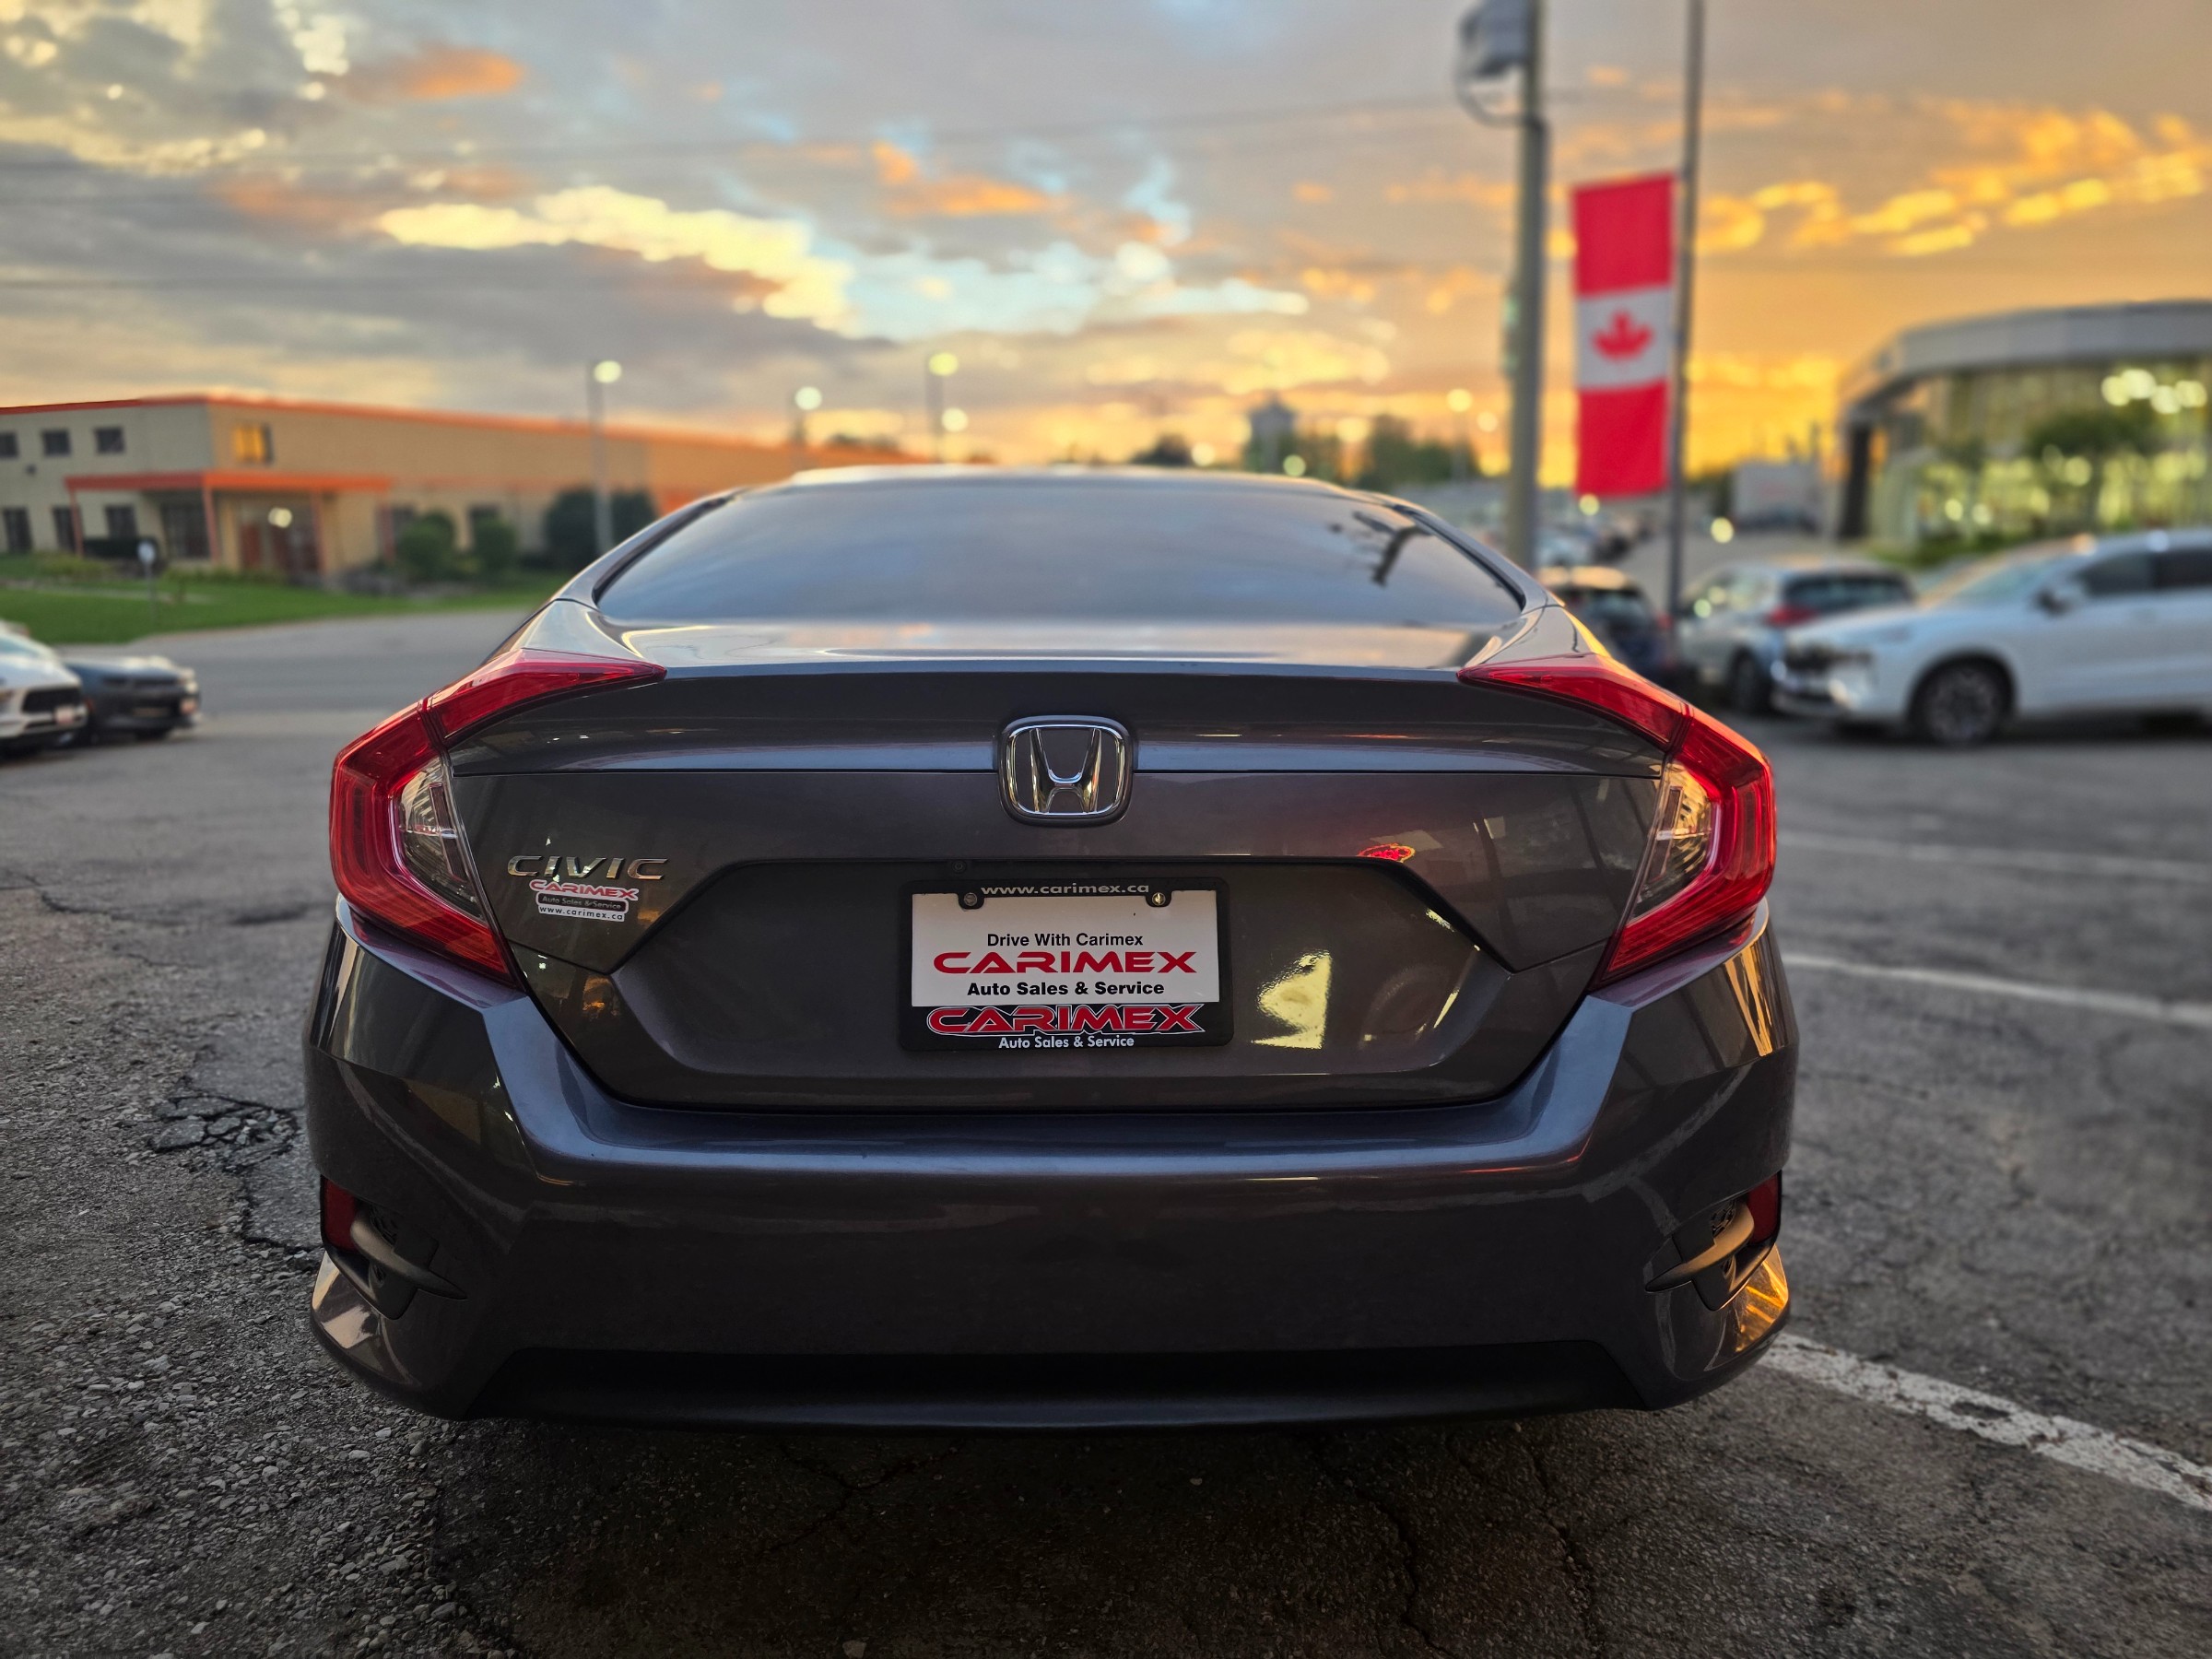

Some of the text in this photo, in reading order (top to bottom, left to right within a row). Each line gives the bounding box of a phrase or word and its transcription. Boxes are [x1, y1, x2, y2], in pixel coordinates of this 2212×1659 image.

[507, 855, 668, 880] CIVIC
[530, 880, 637, 900] CARIMEX
[980, 882, 1149, 895] www.carimex.ca
[542, 895, 560, 903] Auto
[561, 897, 582, 906] Sales
[593, 900, 621, 910] Service
[539, 906, 623, 920] www.carimex.ca
[987, 933, 1144, 947] Drive With Carimex
[933, 950, 1197, 974] CARIMEX
[968, 982, 1165, 995] Auto Sales & Service
[927, 1005, 1203, 1034] CARIMEX
[998, 1035, 1135, 1049] Auto Sales & Service
